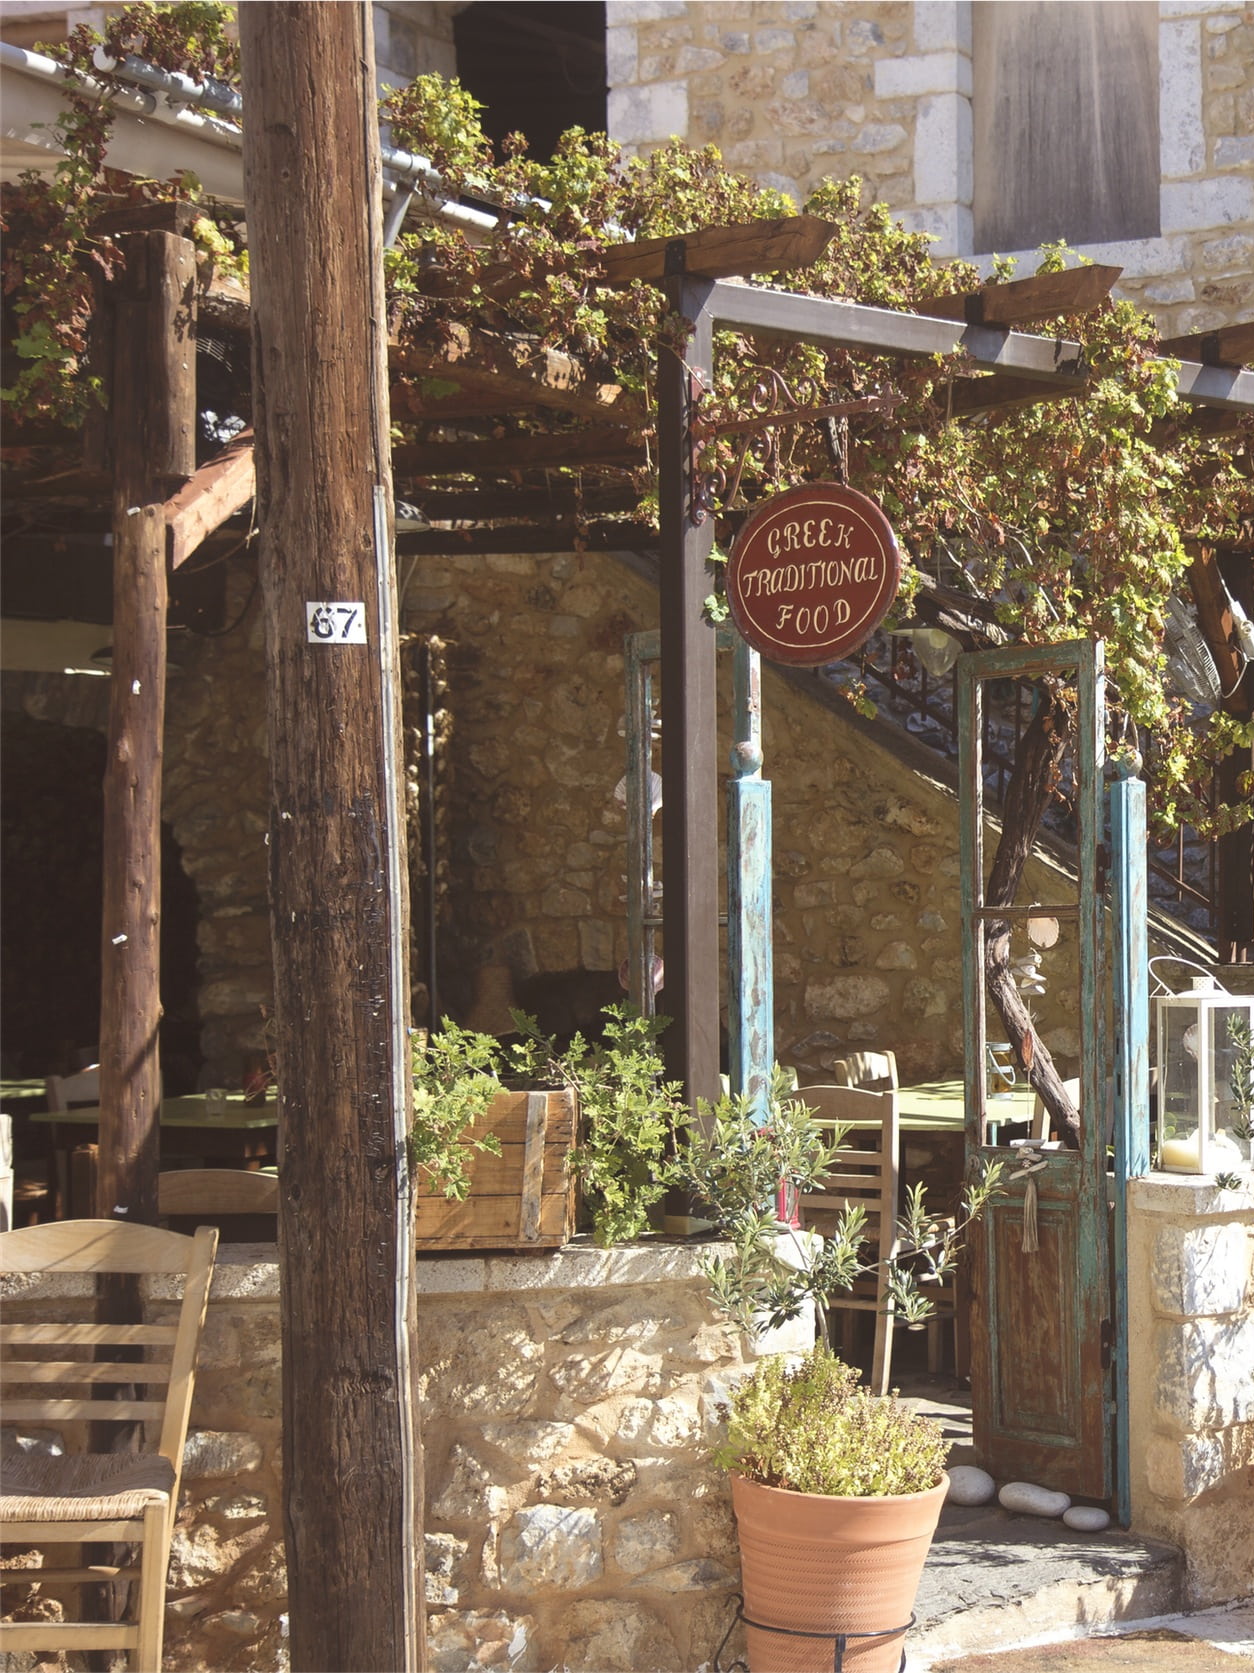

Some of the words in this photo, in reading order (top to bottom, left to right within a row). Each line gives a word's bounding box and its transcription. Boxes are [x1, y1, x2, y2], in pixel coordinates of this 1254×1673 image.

[767, 518, 854, 558] GREEK
[743, 557, 878, 598] TRADITIONAL
[776, 599, 851, 635] FOOD
